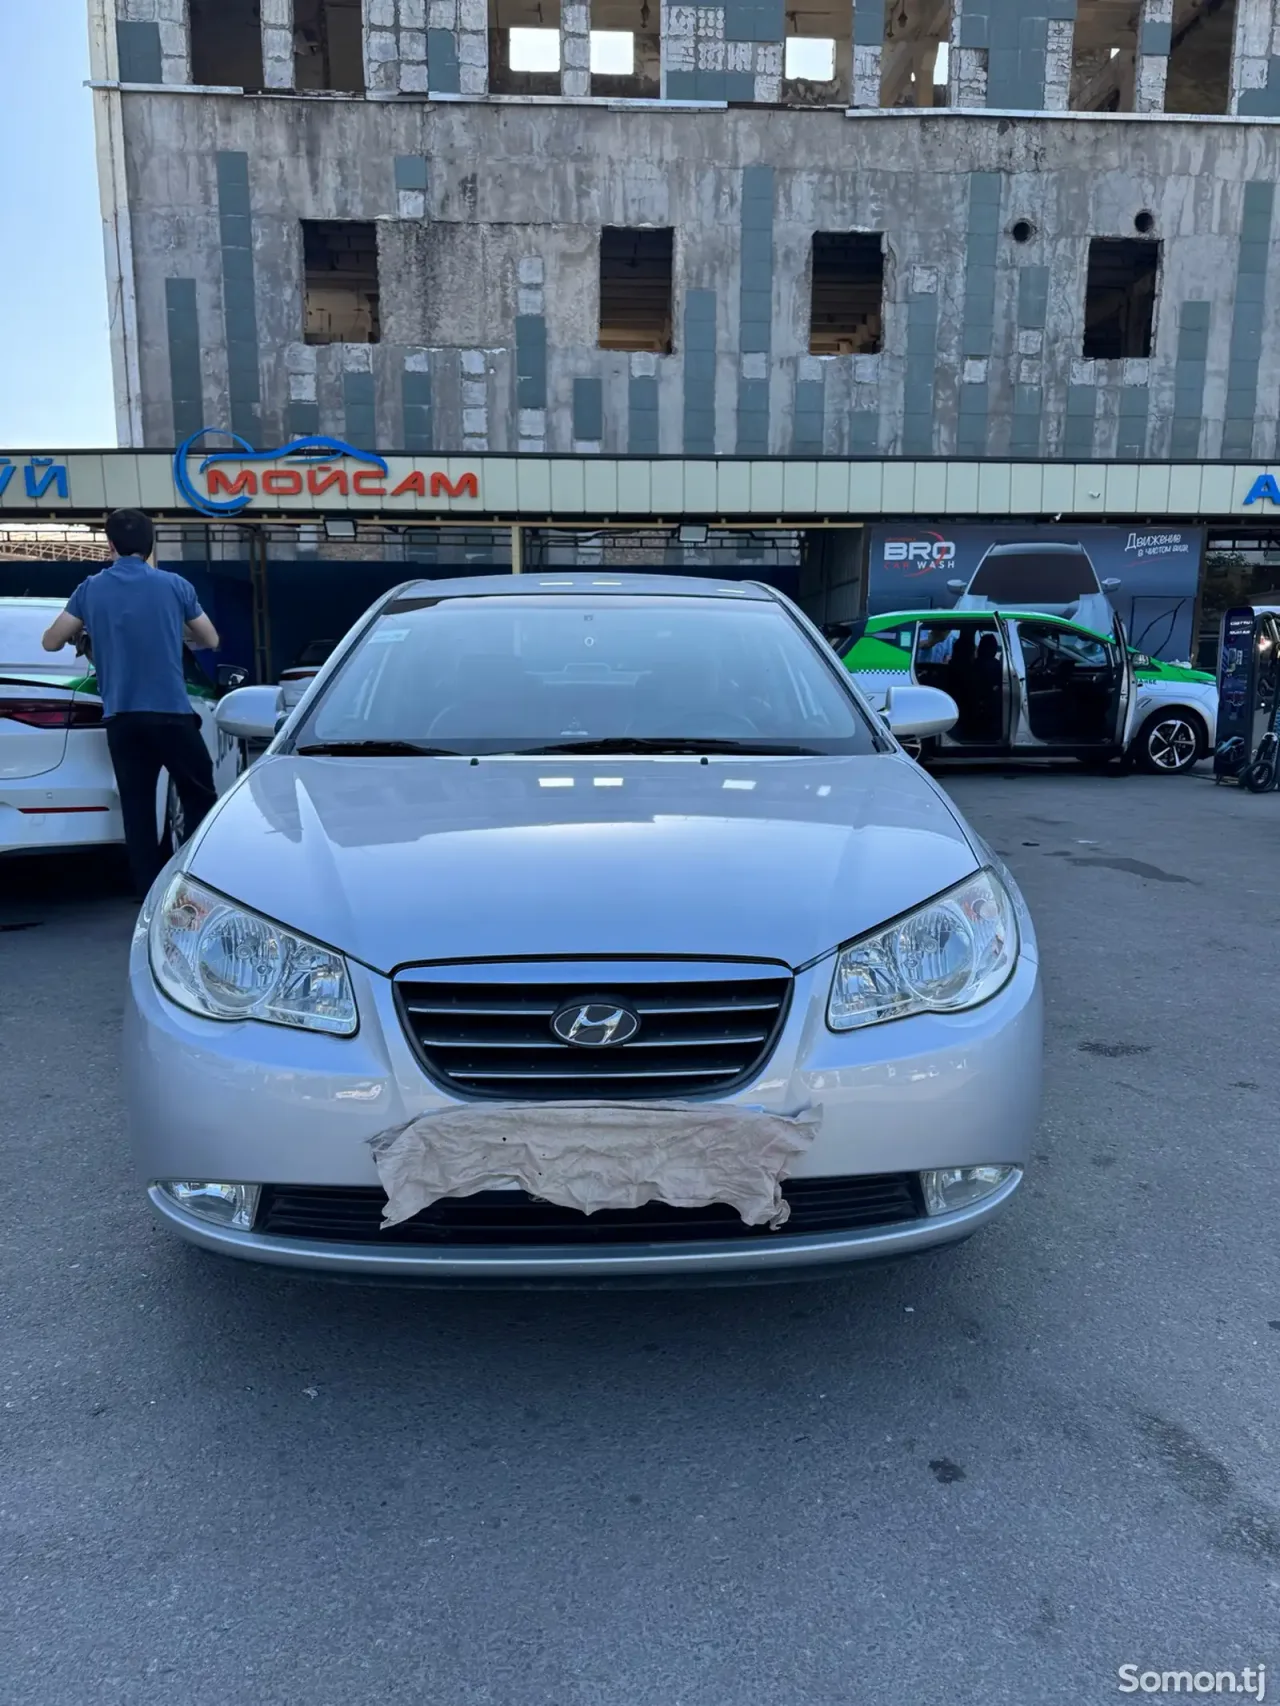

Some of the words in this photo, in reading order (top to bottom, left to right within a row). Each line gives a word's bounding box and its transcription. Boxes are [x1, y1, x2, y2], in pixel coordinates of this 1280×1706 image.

[207, 466, 478, 498] МОЙСАМ
[884, 541, 956, 560] BRO
[917, 560, 955, 569] WASH
